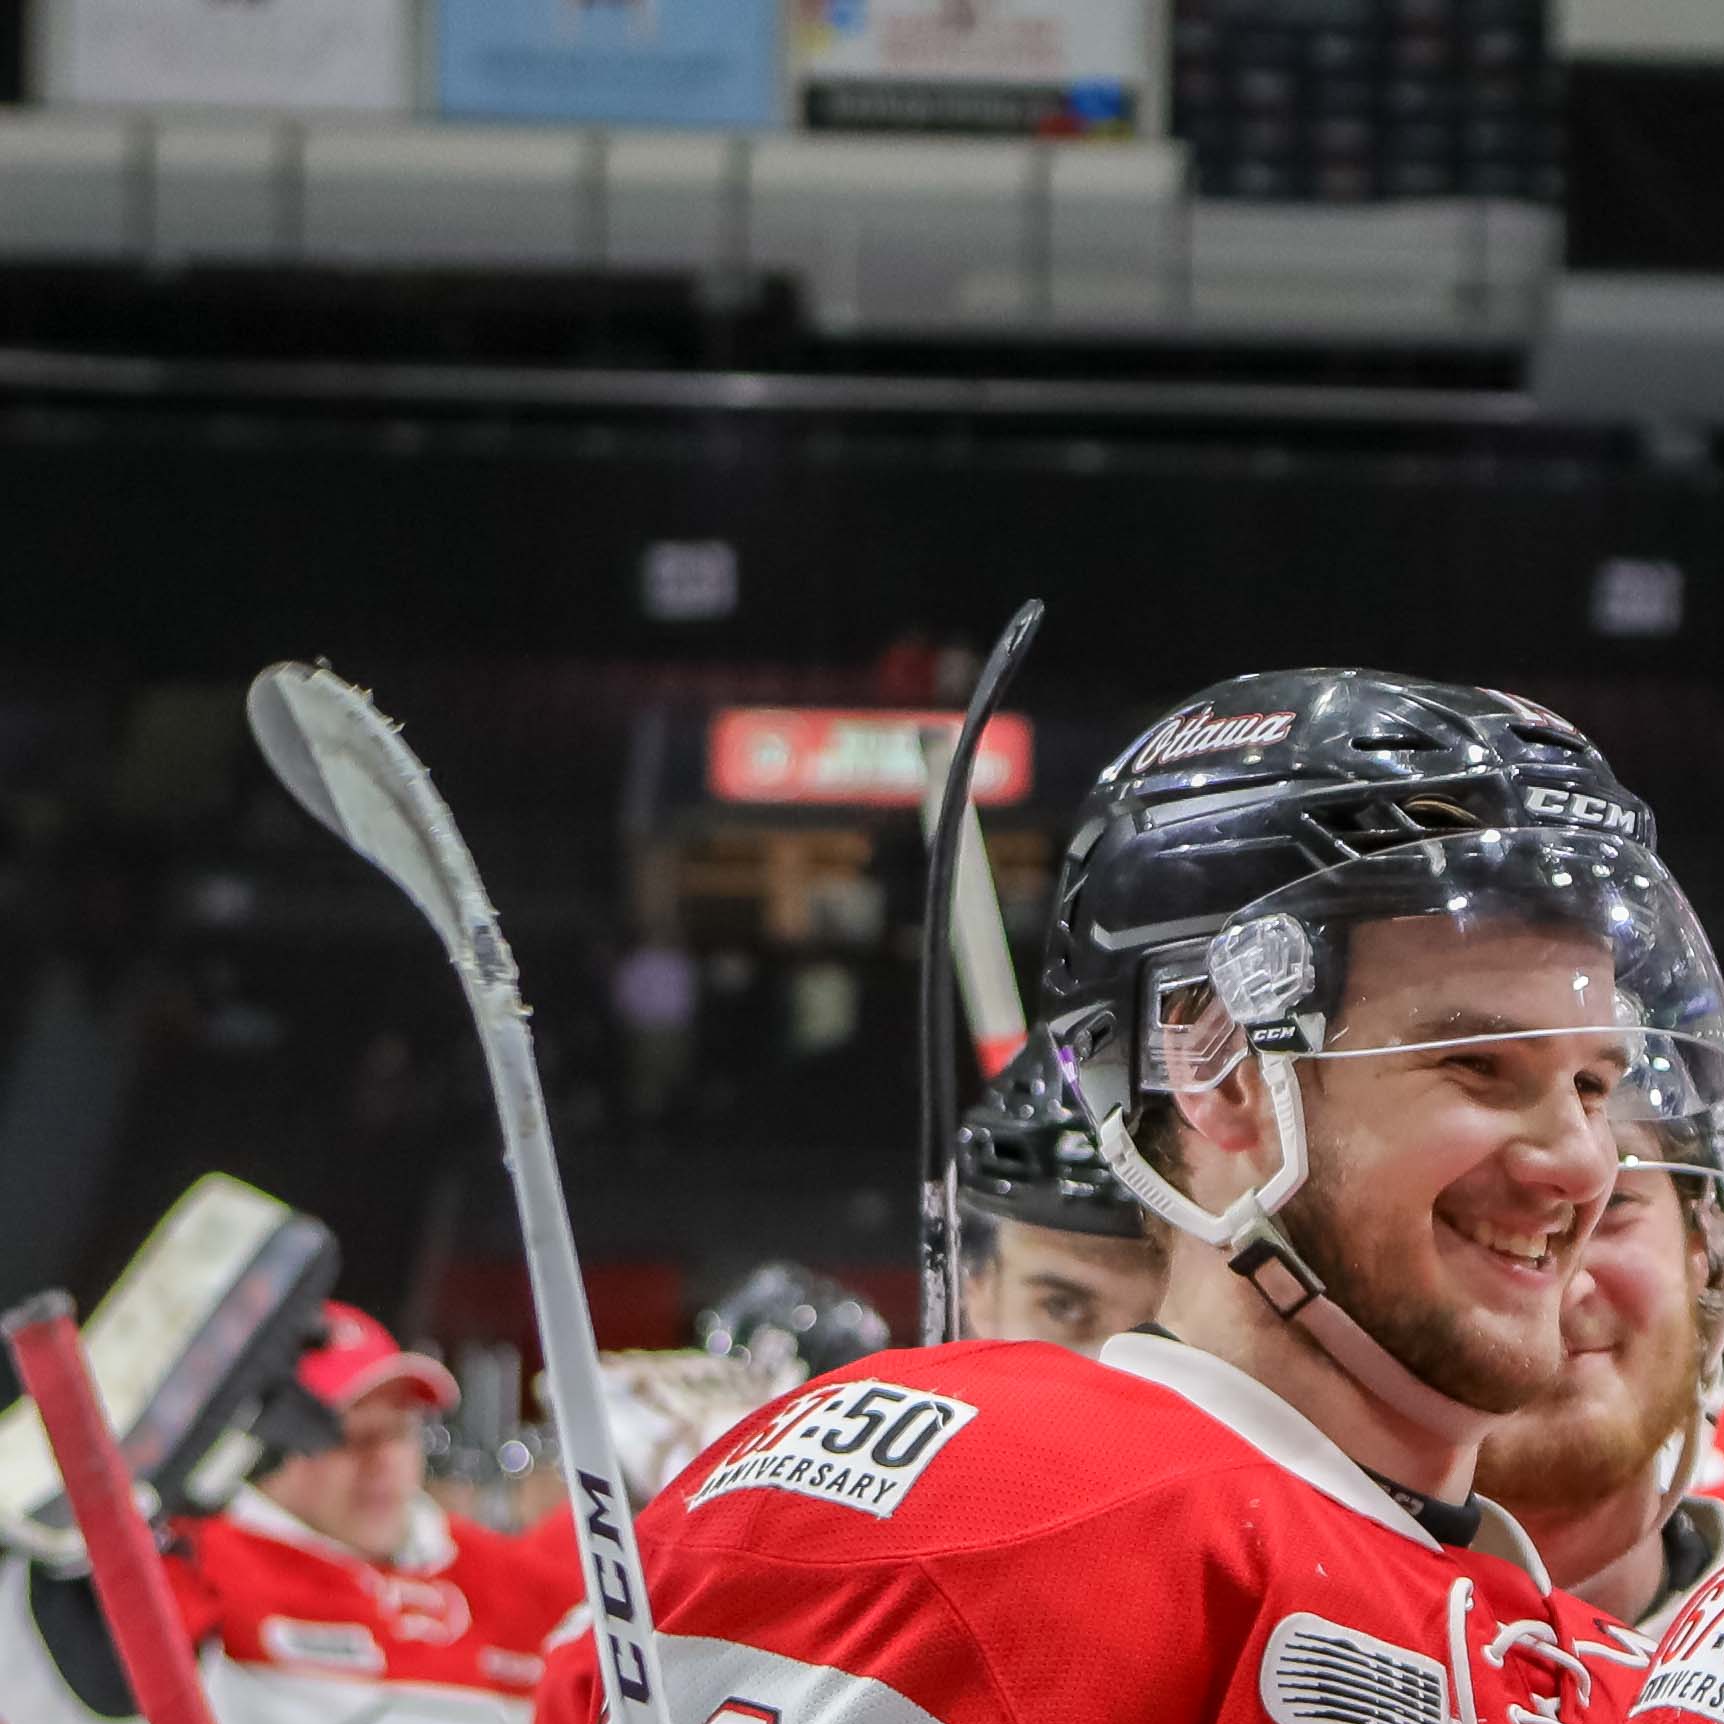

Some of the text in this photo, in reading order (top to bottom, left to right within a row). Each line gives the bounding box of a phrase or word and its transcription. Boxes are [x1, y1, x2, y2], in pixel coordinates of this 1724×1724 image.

[1132, 702, 1297, 772] Ottawa
[1524, 785, 1637, 836] CCM
[1251, 1024, 1296, 1046] CCM
[576, 1468, 652, 1705] CCM
